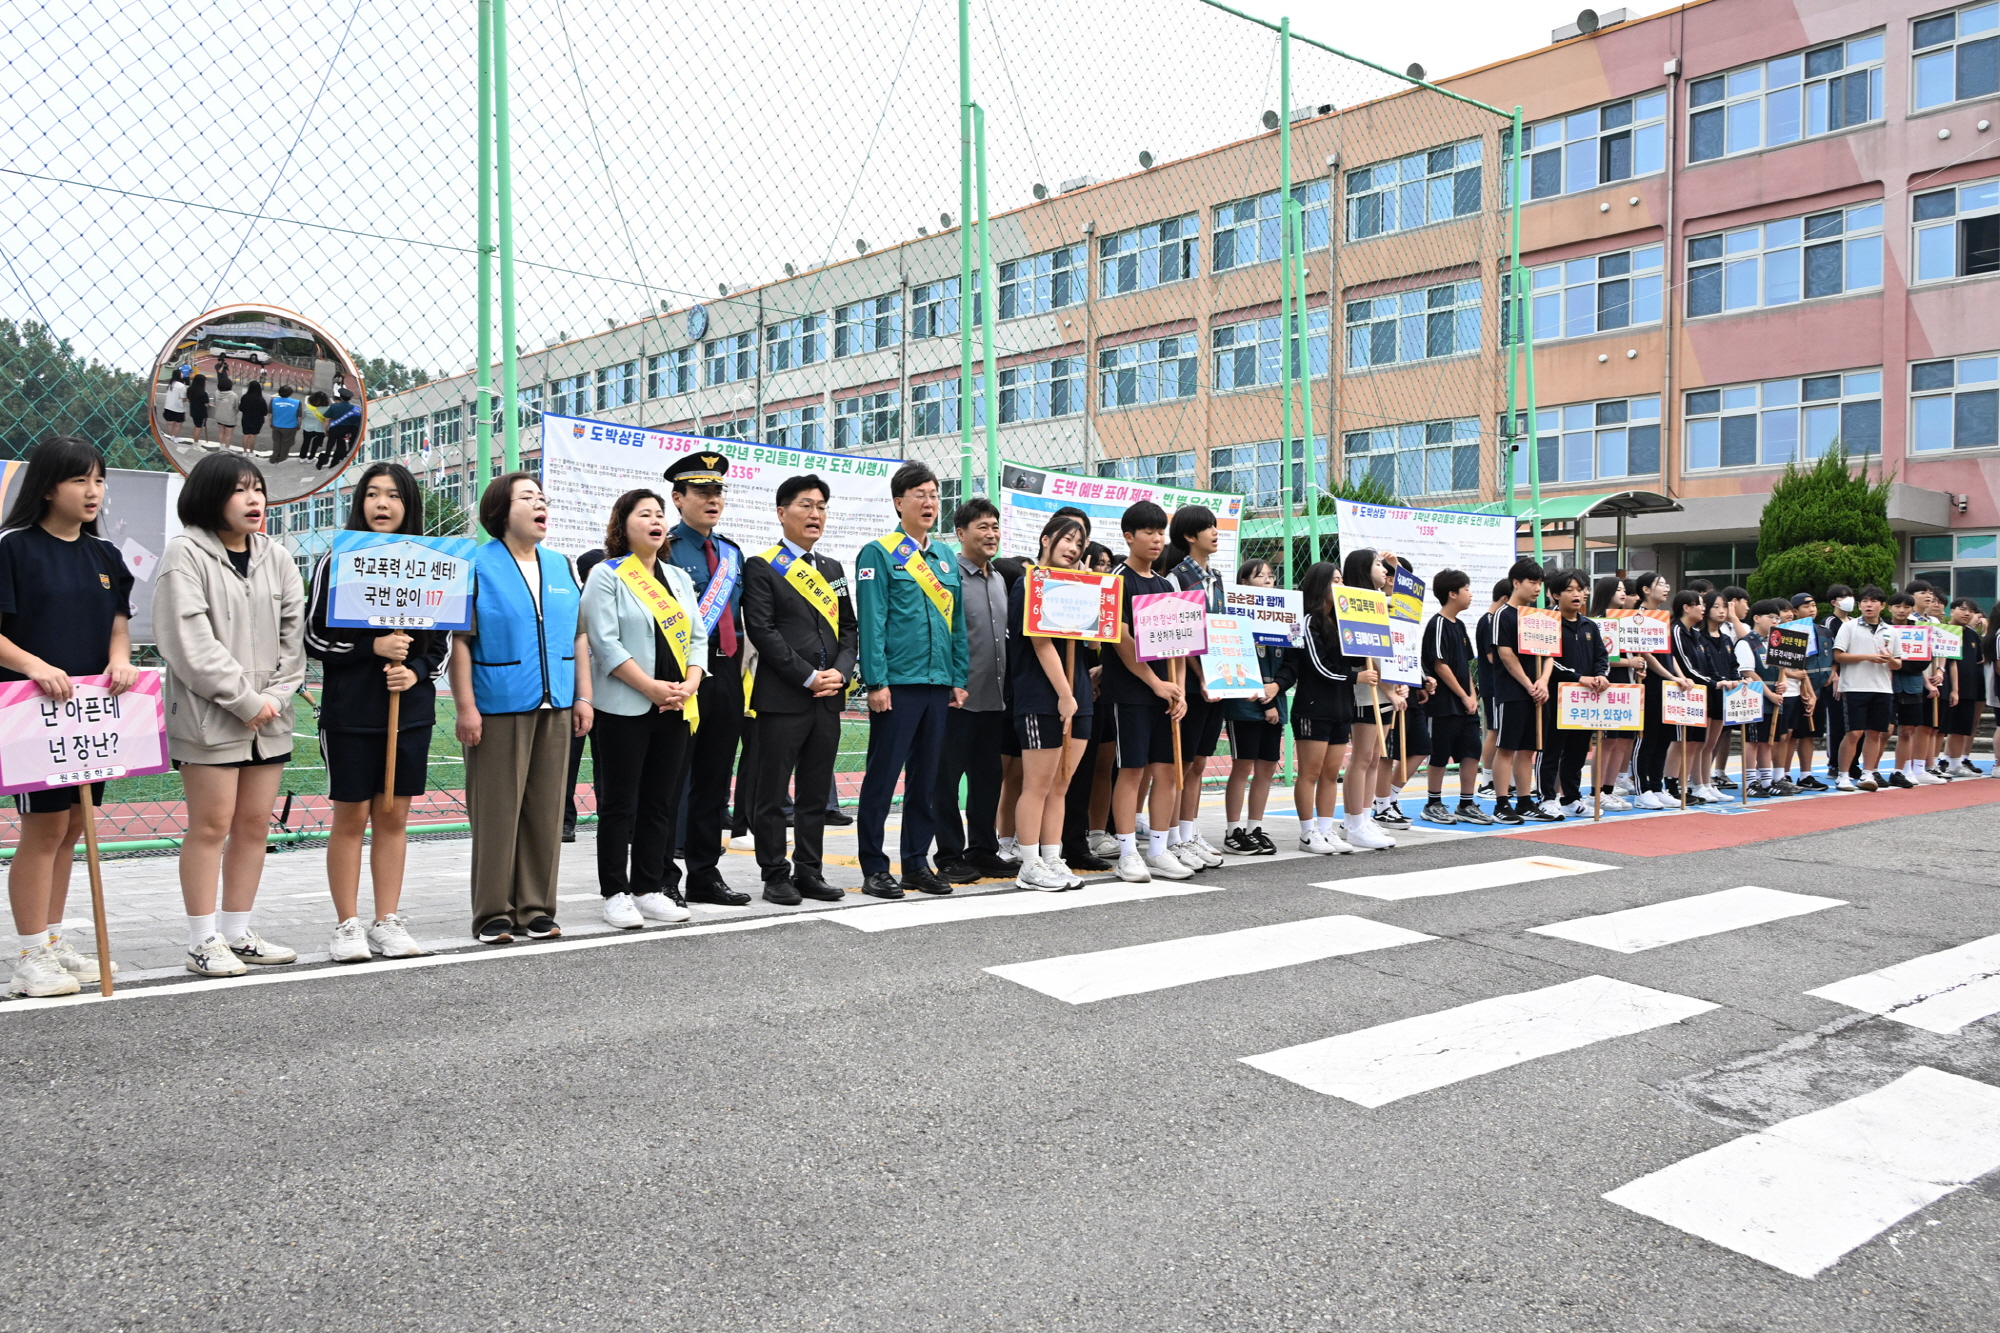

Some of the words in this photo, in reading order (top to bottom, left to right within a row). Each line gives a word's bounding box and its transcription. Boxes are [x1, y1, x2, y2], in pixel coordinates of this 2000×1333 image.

[590, 426, 646, 448] 도박상담
[752, 448, 801, 467] 우리들의
[804, 455, 828, 471] 생각
[829, 458, 853, 474] 도전
[855, 461, 889, 478] 사행시
[1052, 478, 1078, 497] 도박
[1078, 482, 1103, 499] 예방
[1104, 485, 1129, 501] 표어
[1163, 493, 1174, 508] 반
[1360, 506, 1387, 519] 도박상담
[1413, 512, 1430, 523] 3학년
[1431, 513, 1456, 525] 우리들의
[1456, 515, 1469, 525] 생각
[1470, 516, 1482, 527] 도전
[354, 556, 401, 578] 학교폭력
[404, 559, 427, 579] 신고
[430, 561, 456, 581] 센터!
[796, 569, 833, 606] 학교폭력
[1413, 582, 1425, 597] OUT
[364, 586, 391, 607] 국번
[396, 587, 421, 608] 없이
[425, 590, 444, 606] 117
[1227, 592, 1265, 606] 곰순경과
[1266, 595, 1285, 608] 함께
[1349, 597, 1376, 614] 학교폭력
[1376, 601, 1385, 615] NO
[660, 611, 685, 631] zero
[1140, 615, 1151, 627] 내가
[1152, 614, 1159, 627] 한
[1160, 612, 1178, 626] 장난이
[1179, 610, 1202, 624] 친구에게
[1257, 609, 1297, 624] 지키자곰!
[1603, 621, 1618, 632] 담배
[1627, 627, 1639, 635] 피워
[1640, 627, 1665, 636] 자살행위
[1149, 631, 1155, 643] 큰
[1157, 629, 1174, 643] 상처가
[1175, 627, 1195, 640] 됩니다.
[1380, 634, 1391, 648] NO
[1627, 637, 1640, 645] 피워
[1640, 637, 1665, 646] 살인행위
[1900, 631, 1924, 641] 교실
[1901, 642, 1924, 655] 학교
[1570, 690, 1601, 704] 친구야
[1606, 691, 1630, 705] 힘내!
[1729, 699, 1747, 710] 청소년
[1747, 697, 1759, 708] 흡연
[1569, 707, 1600, 721] 우리가
[1603, 708, 1633, 722] 있잖아
